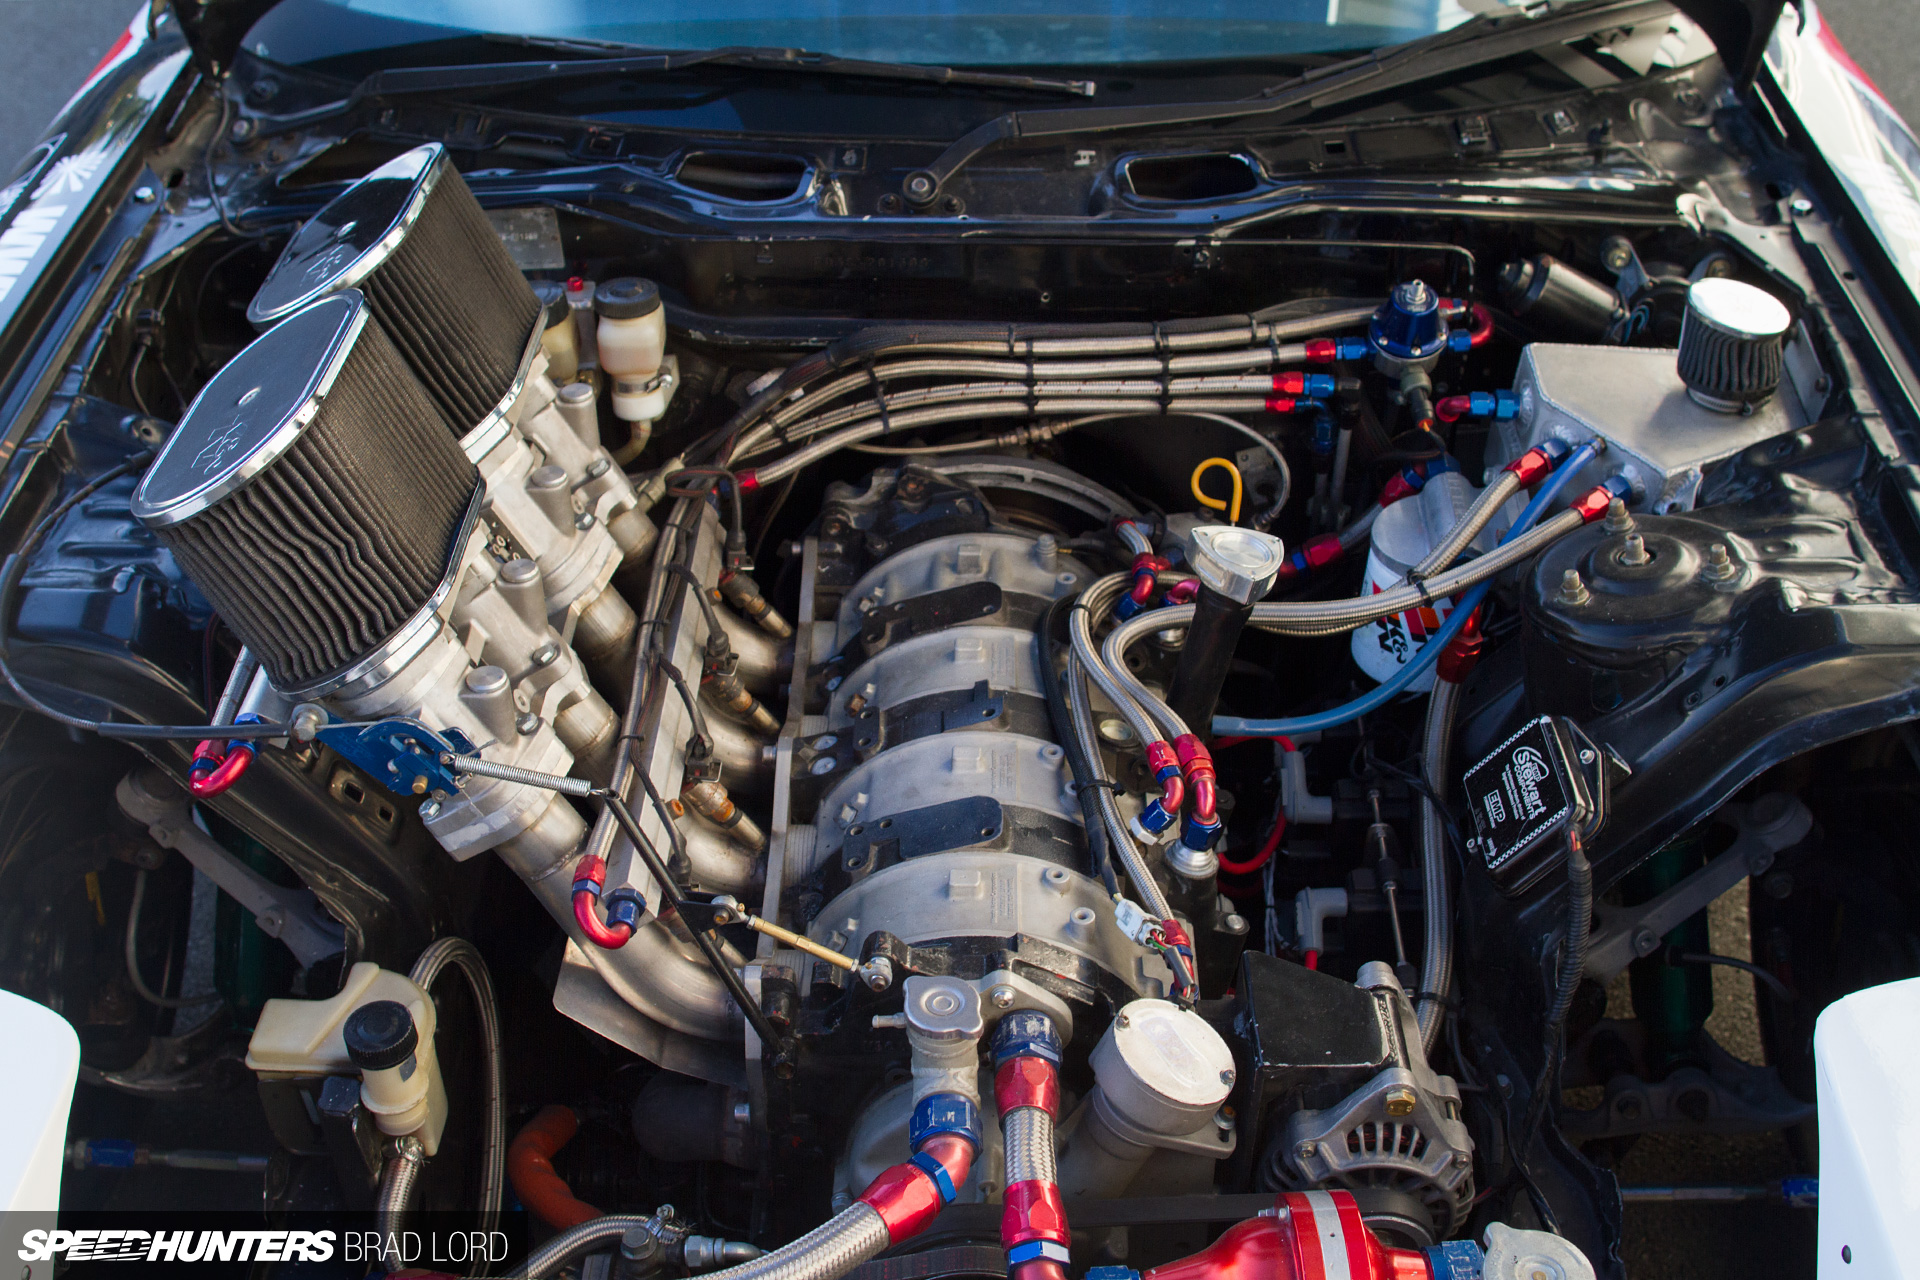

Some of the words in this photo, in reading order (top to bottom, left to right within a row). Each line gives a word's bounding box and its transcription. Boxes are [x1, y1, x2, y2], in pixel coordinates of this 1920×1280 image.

[1488, 789, 1505, 822] EMP
[1513, 765, 1536, 821] COMPONENTS
[1516, 750, 1547, 817] Stewart
